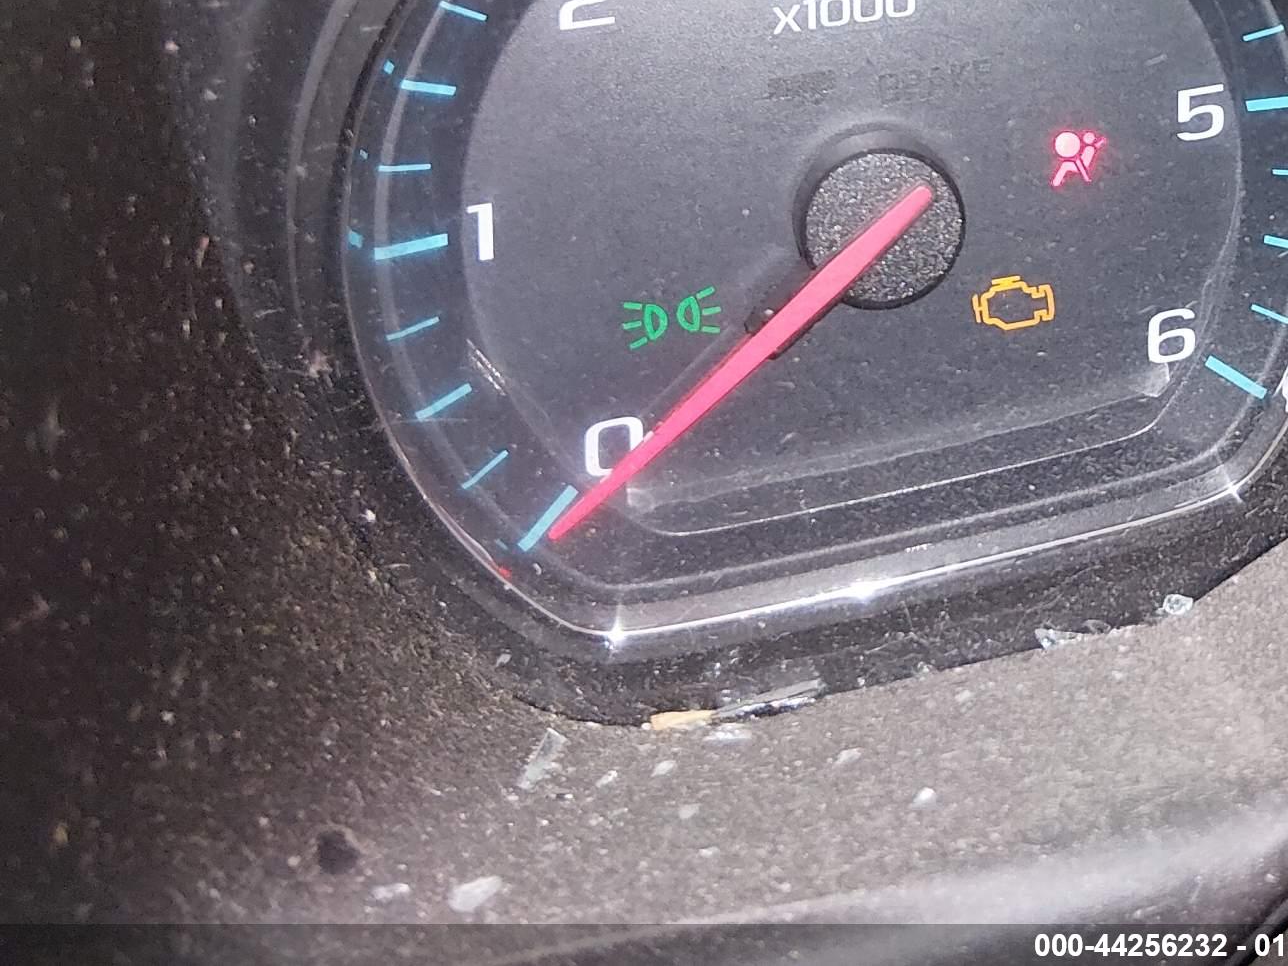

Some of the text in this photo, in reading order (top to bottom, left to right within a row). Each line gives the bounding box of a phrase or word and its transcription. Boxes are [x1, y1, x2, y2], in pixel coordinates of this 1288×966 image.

[1175, 83, 1225, 142] 5
[464, 202, 496, 262] 1
[1146, 305, 1197, 365] 6
[584, 416, 644, 477] 0
